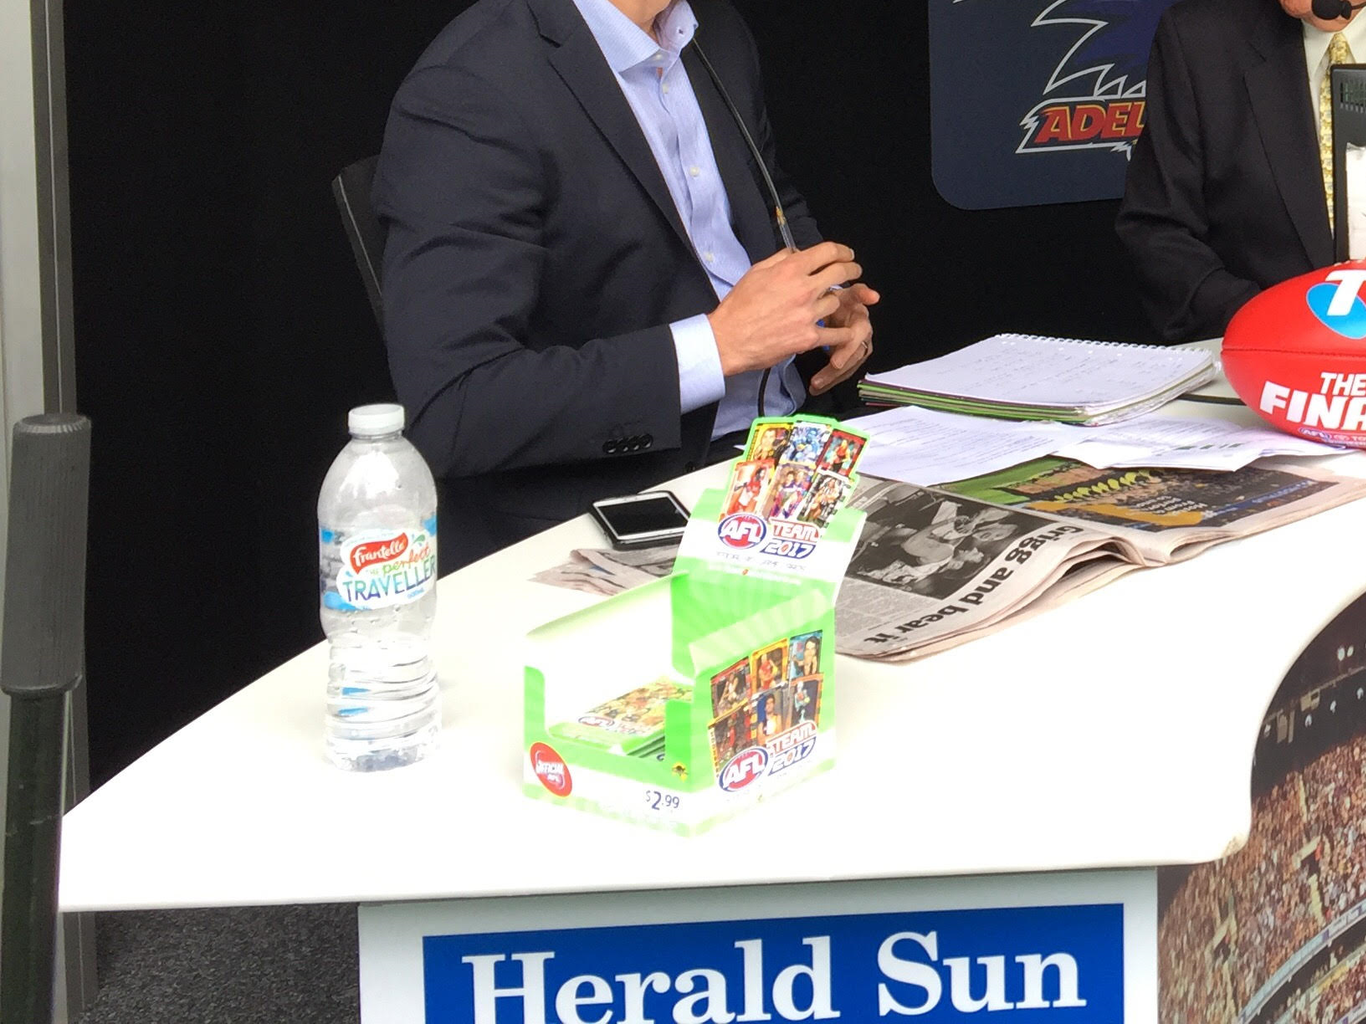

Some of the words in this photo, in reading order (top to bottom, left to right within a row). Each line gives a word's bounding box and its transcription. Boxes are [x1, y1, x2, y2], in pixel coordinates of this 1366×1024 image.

[719, 518, 763, 544] AFL
[772, 521, 818, 541] TEAM
[1005, 525, 1084, 565] Grigg
[763, 541, 815, 559] 2017
[342, 554, 436, 603] TRAVELLER
[958, 566, 1014, 606] and
[894, 604, 970, 635] bear
[863, 631, 899, 644] it
[722, 753, 765, 789] AFL
[770, 721, 816, 756] TEAM
[771, 739, 815, 773] 2017
[645, 790, 681, 811] $2.99
[461, 933, 841, 1024] Herald
[876, 930, 1088, 1019] Sun
